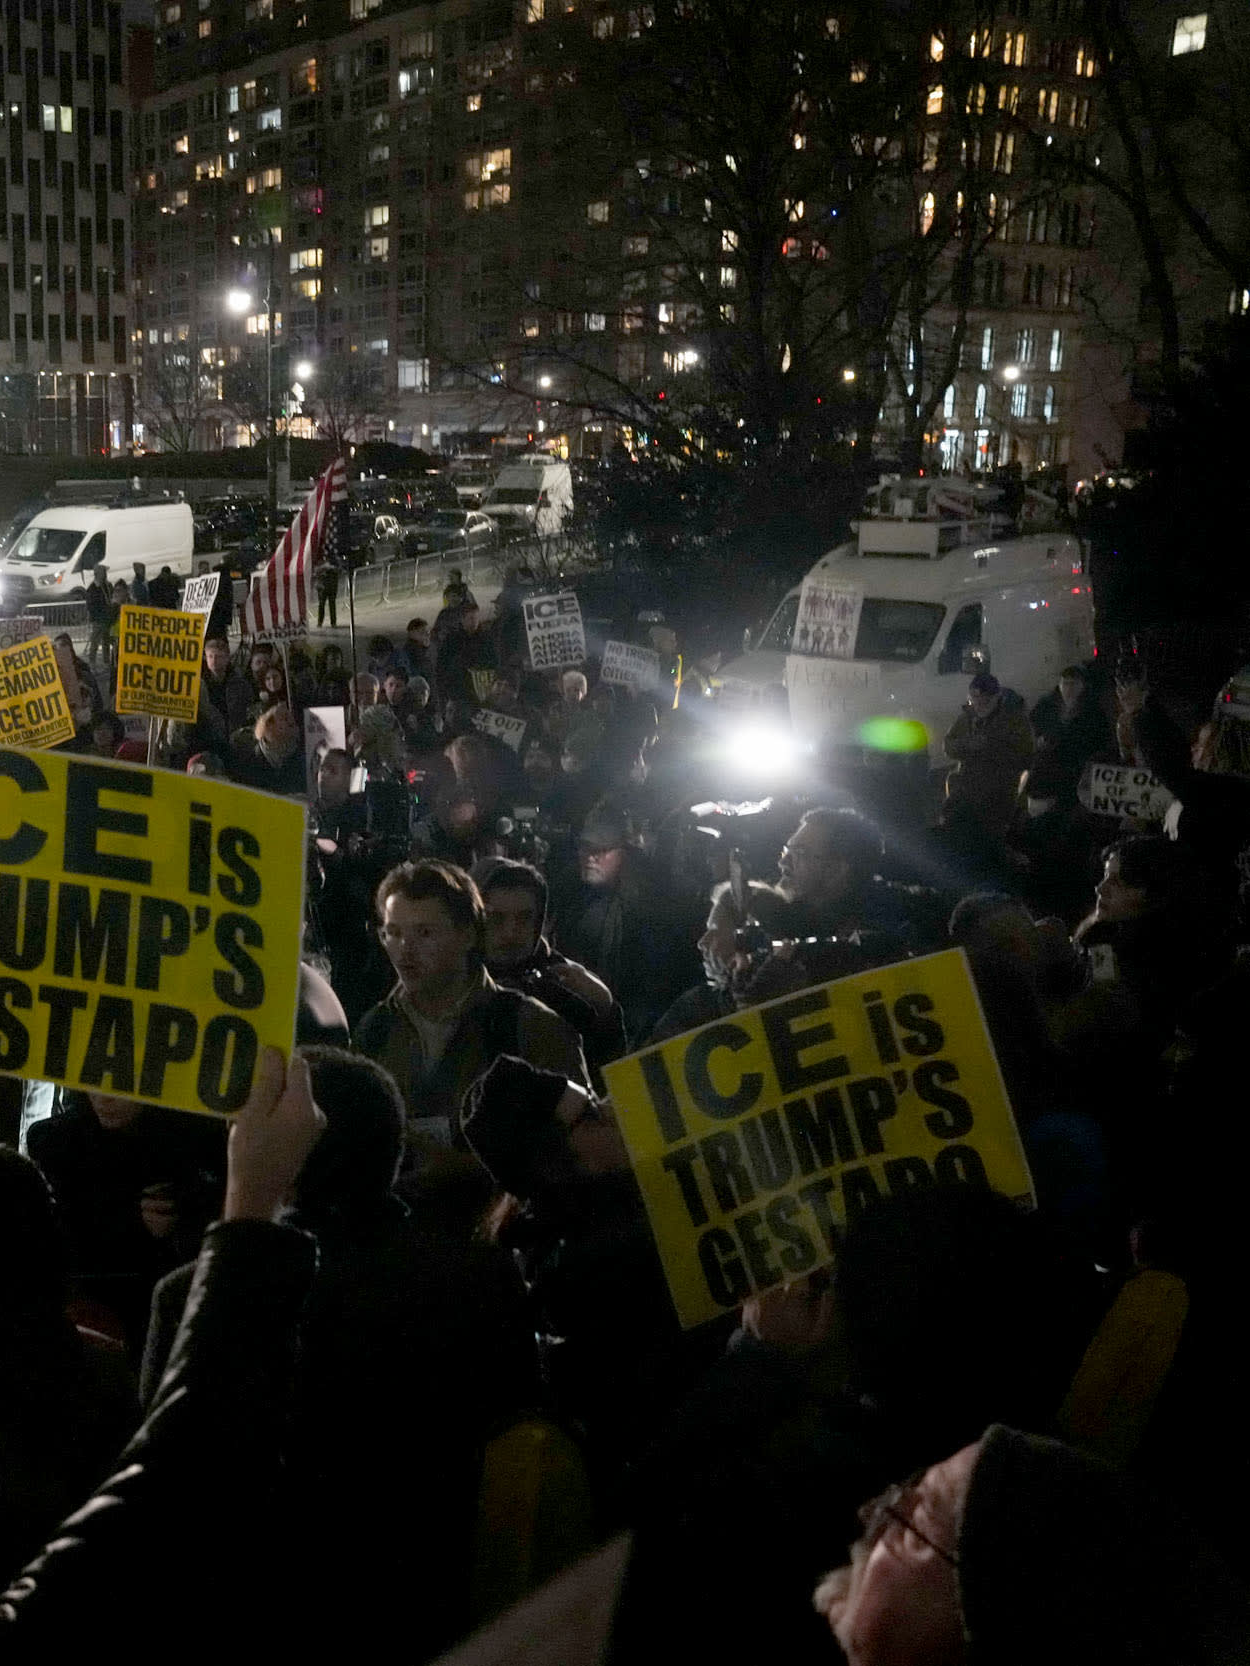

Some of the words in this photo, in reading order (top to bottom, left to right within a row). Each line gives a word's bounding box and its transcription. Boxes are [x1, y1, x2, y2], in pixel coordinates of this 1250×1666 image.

[526, 597, 578, 620] ICE
[126, 612, 150, 632] THE
[152, 614, 202, 637] PEOPLE
[528, 616, 580, 631] FUERA
[2, 641, 51, 673] PEOPLE
[125, 632, 199, 662] DEMAND
[123, 663, 152, 690] ICE
[156, 668, 196, 696] OUT
[25, 690, 63, 725] OUT
[494, 715, 524, 732] OUT
[1095, 767, 1127, 784] ICE
[1105, 785, 1128, 796] OF
[1093, 795, 1138, 817] NYC
[187, 801, 262, 908] is
[638, 989, 850, 1144] ICE
[862, 990, 945, 1066] is
[662, 1060, 975, 1228] TRUMP'S
